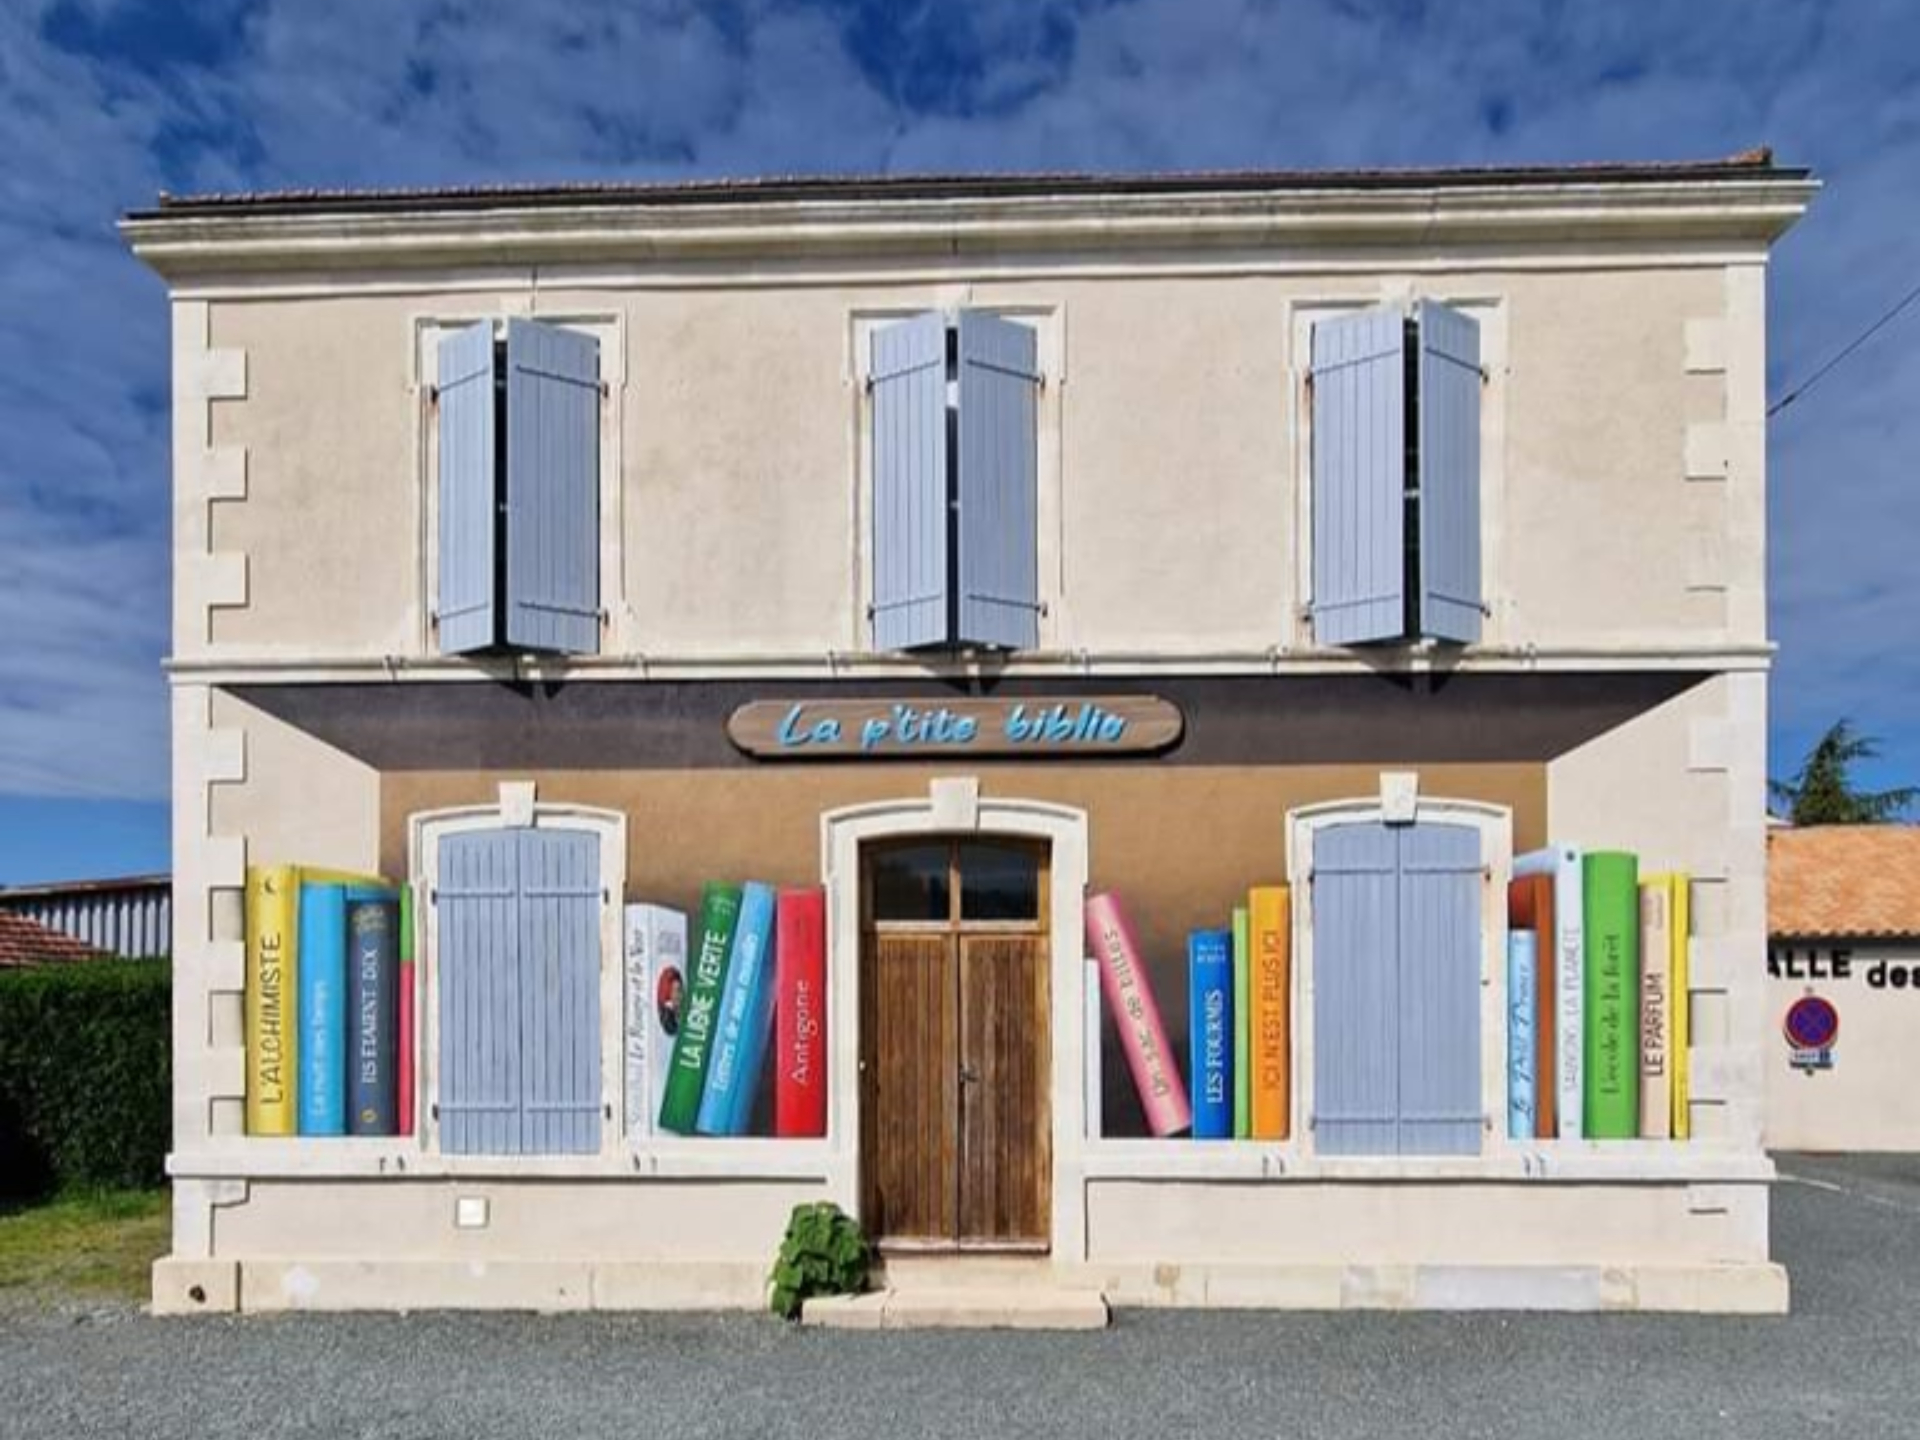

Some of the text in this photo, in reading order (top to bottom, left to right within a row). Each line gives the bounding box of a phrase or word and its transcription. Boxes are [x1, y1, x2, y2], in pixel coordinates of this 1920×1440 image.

[777, 702, 1128, 749] La p'tite biblio
[1263, 929, 1280, 954] ICI
[361, 948, 378, 981] DIX
[1262, 958, 1280, 1002] PLUS
[680, 929, 727, 1069] LA LIGNE VERTE
[1126, 996, 1144, 1020] de
[1600, 982, 1620, 1001] la
[259, 932, 283, 1104] L'ALCHIMISTE
[792, 979, 818, 1086] Antigone
[1600, 1005, 1620, 1029] de
[1643, 972, 1663, 1078] LE PARFUM
[1206, 1071, 1223, 1103] LES
[1263, 1065, 1280, 1090] ICI
